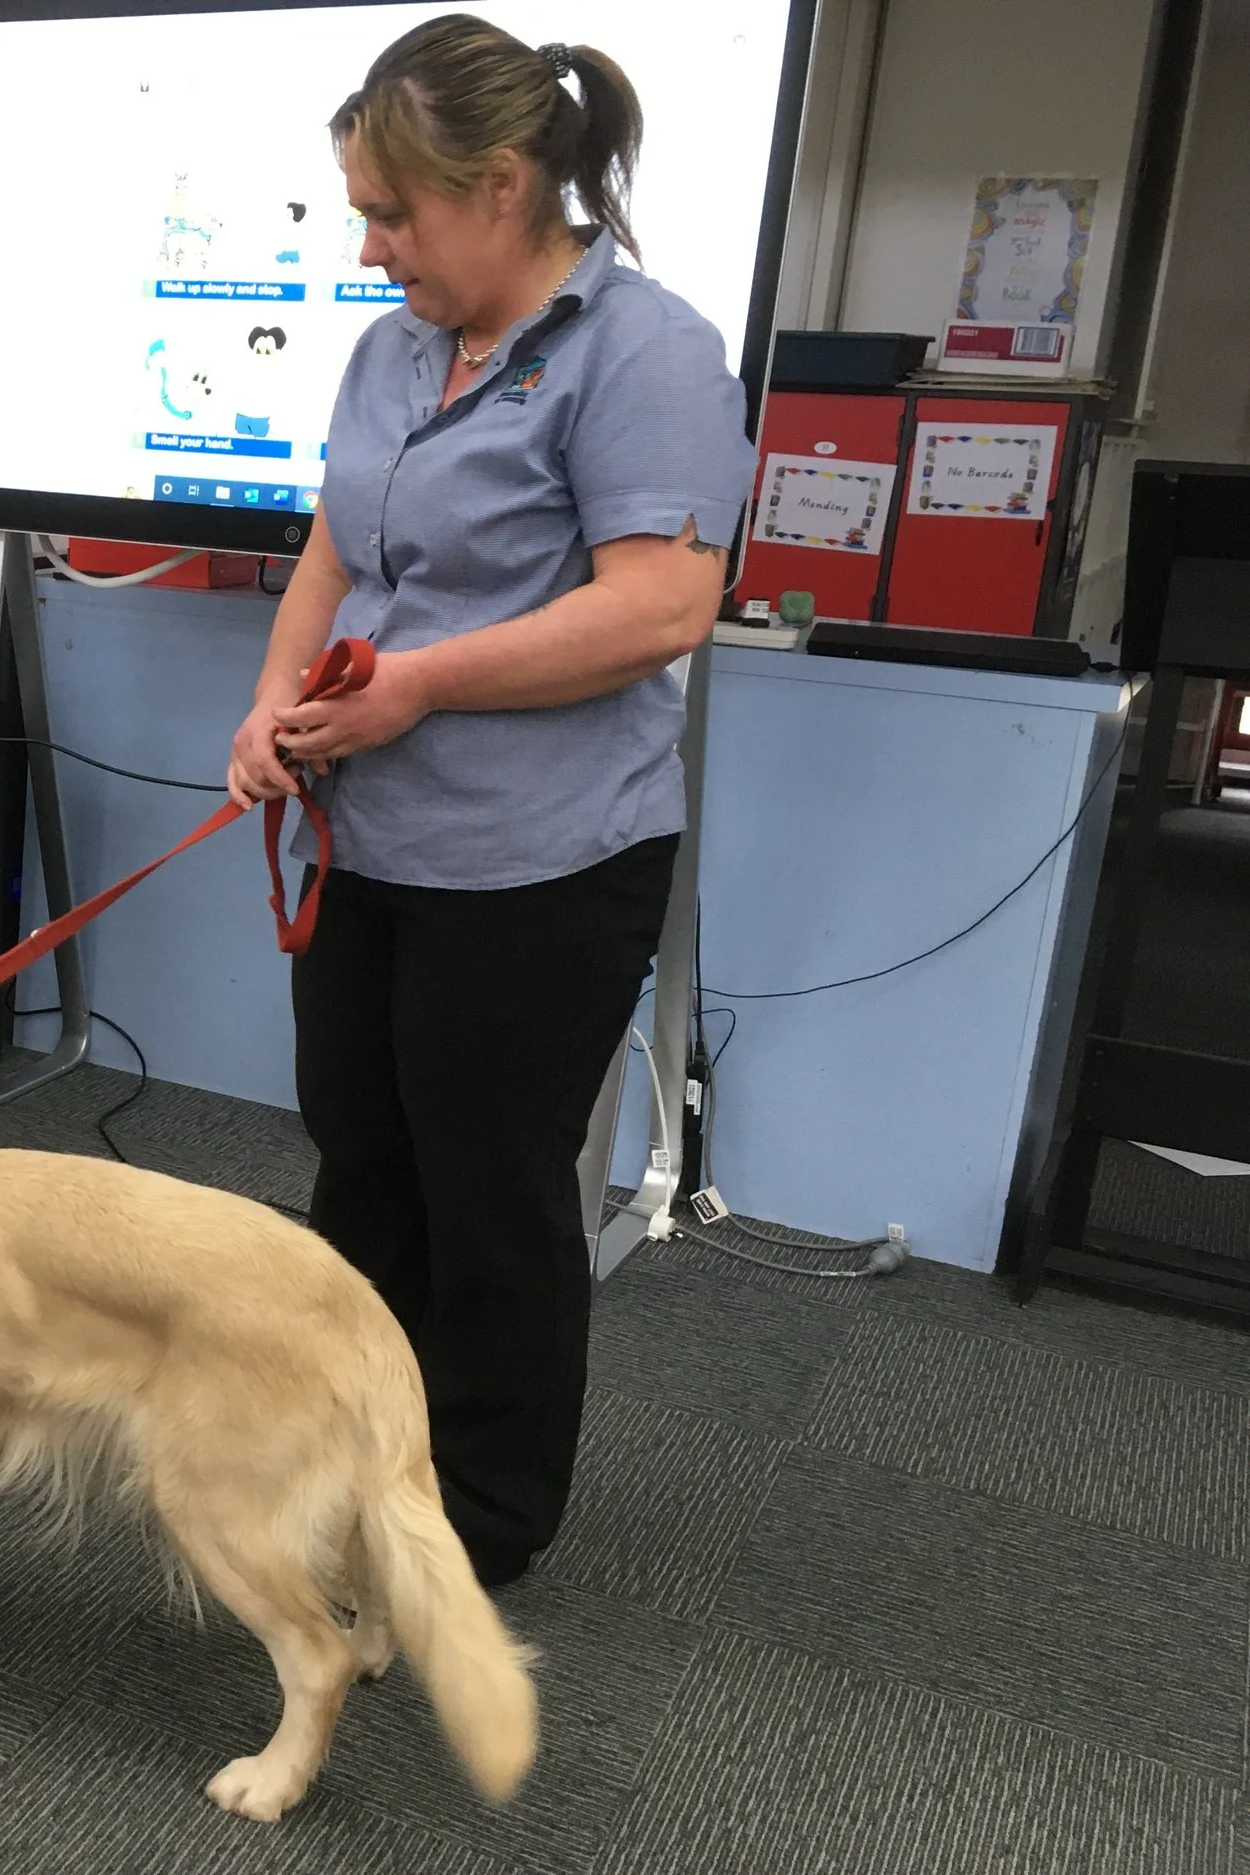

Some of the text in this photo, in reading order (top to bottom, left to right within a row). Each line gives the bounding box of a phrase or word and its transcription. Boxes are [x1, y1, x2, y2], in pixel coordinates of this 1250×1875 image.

[162, 281, 186, 293] Walk
[188, 284, 201, 295] up
[203, 283, 235, 297] slowly
[236, 284, 257, 295] and
[340, 284, 363, 297] Ask
[364, 284, 384, 298] the
[180, 438, 203, 450] your
[205, 437, 233, 450] hand.
[947, 465, 1015, 480] No Barcode
[797, 496, 850, 516] Mending
